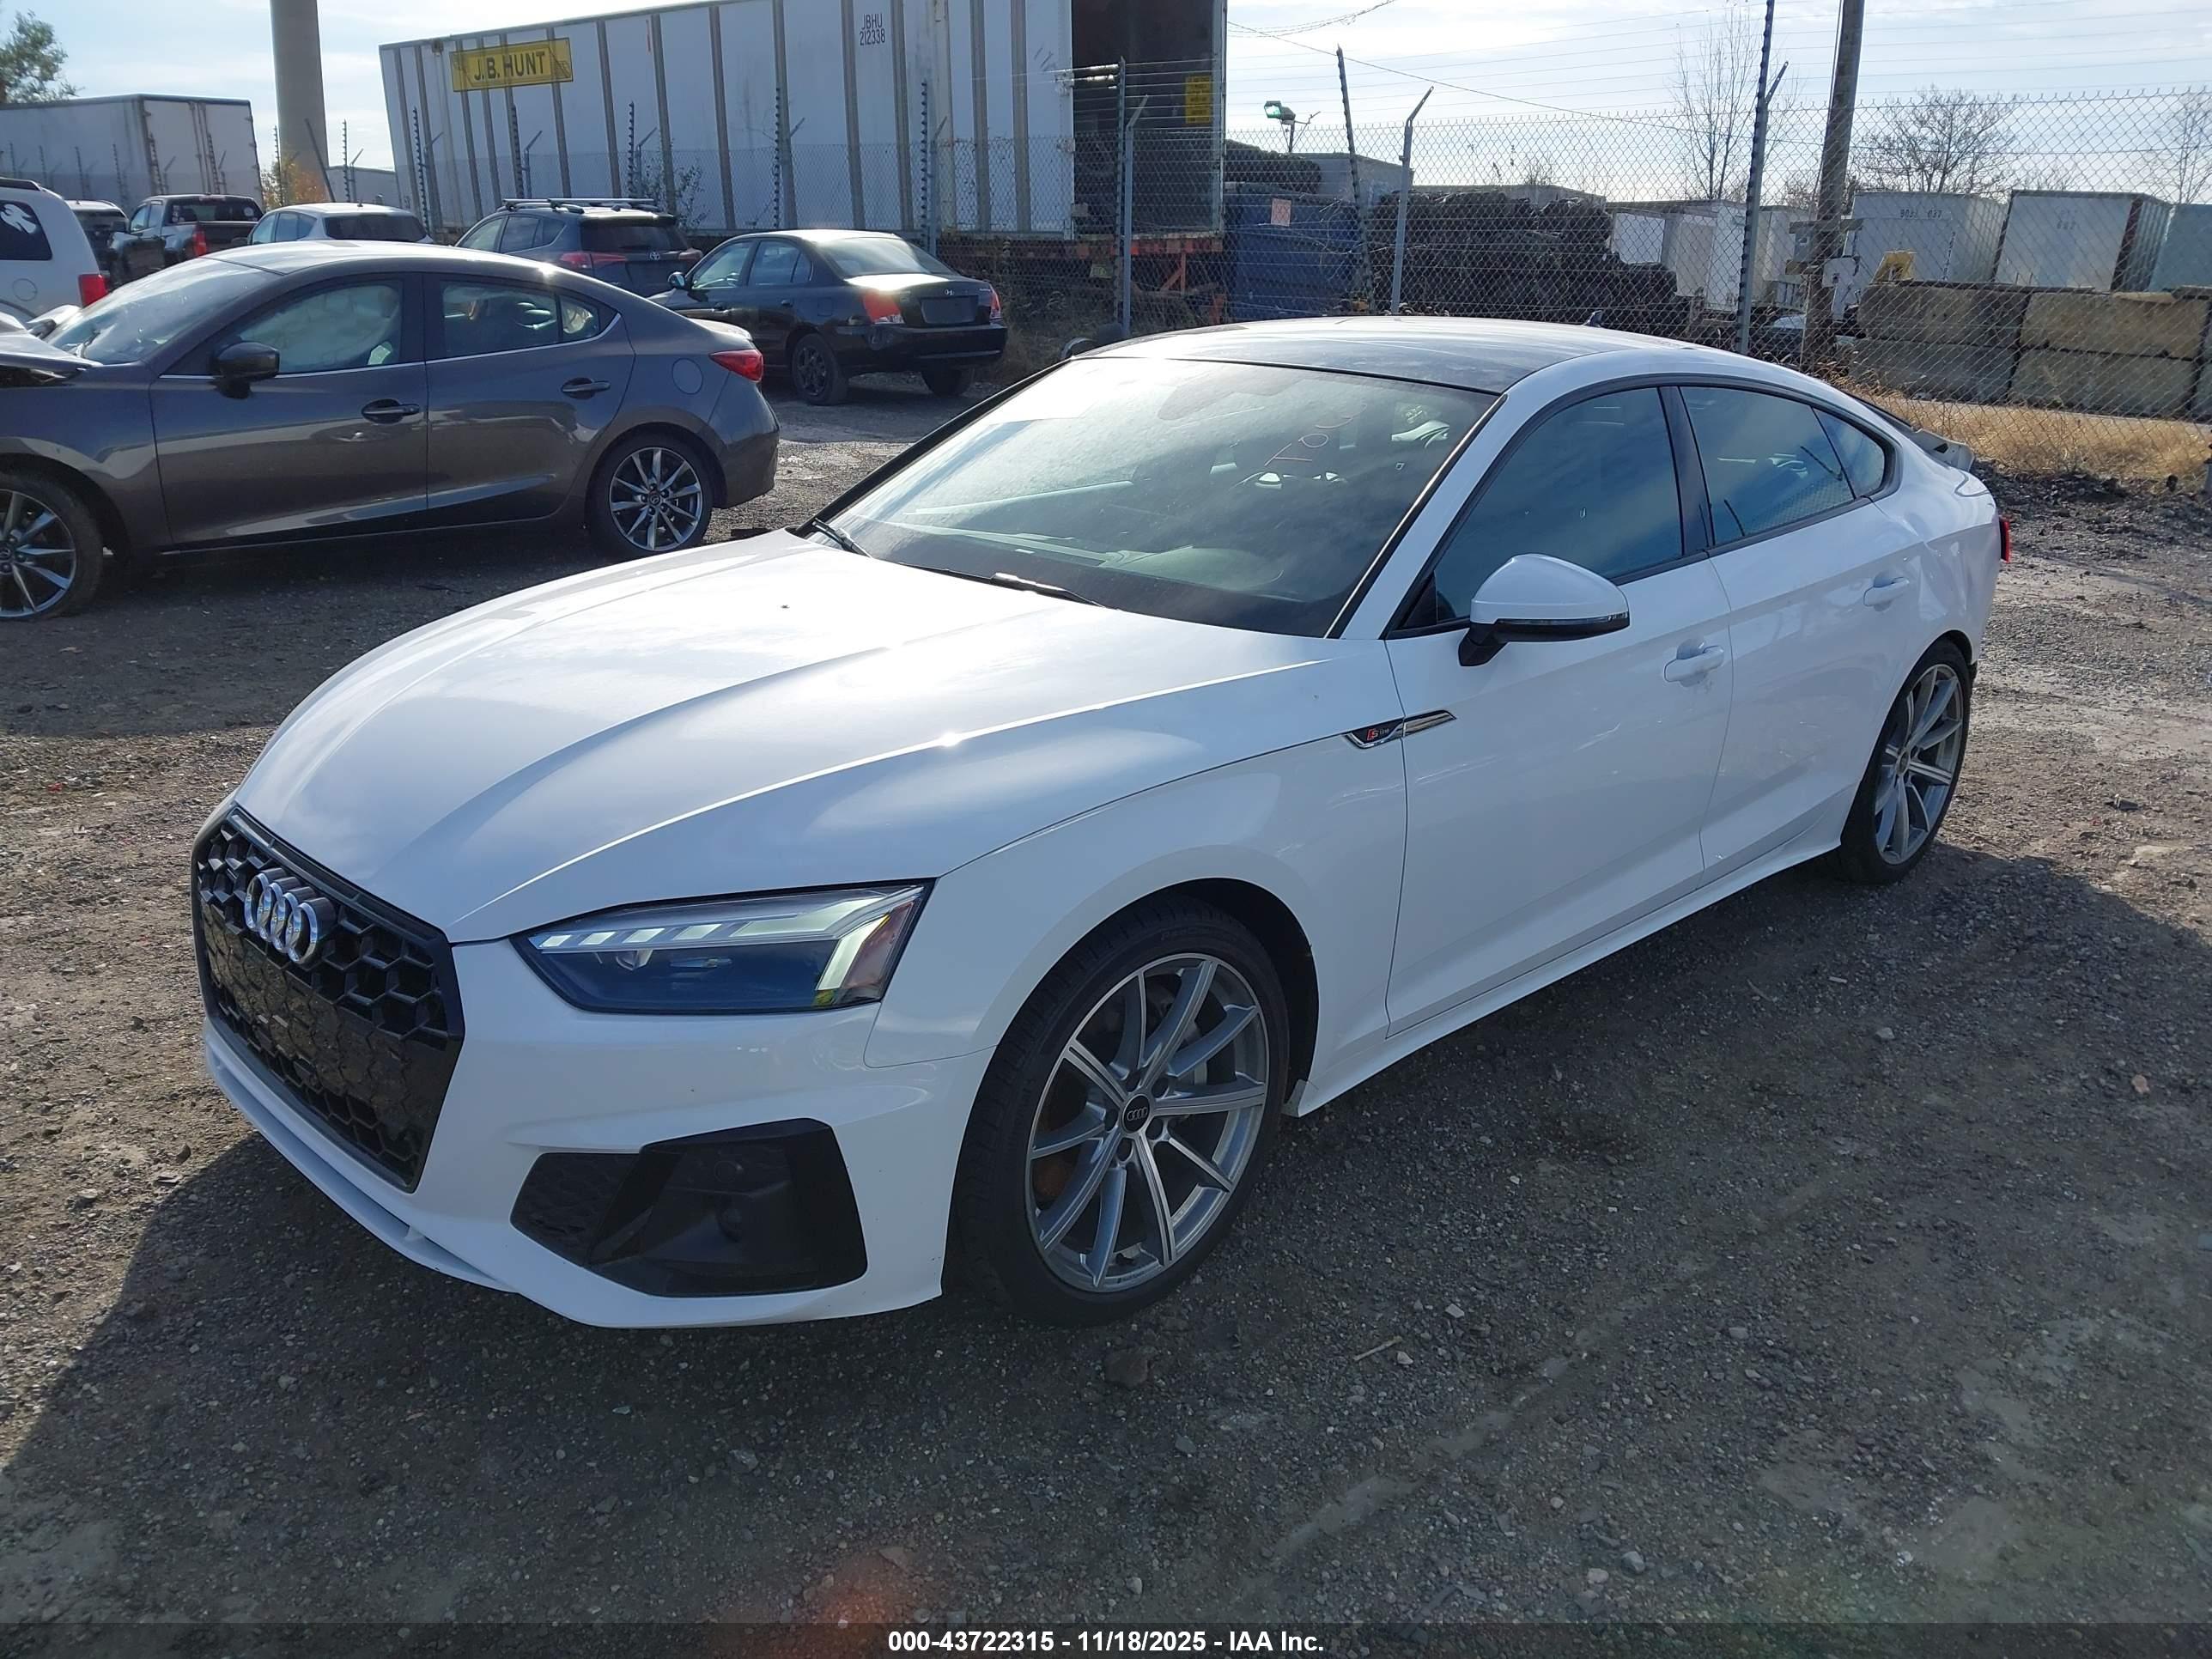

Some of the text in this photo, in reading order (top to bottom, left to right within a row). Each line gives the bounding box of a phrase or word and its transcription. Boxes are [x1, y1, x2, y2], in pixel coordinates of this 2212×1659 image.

[861, 13, 883, 30] JBHU
[860, 28, 886, 46] 212338
[502, 51, 545, 76] HUNT
